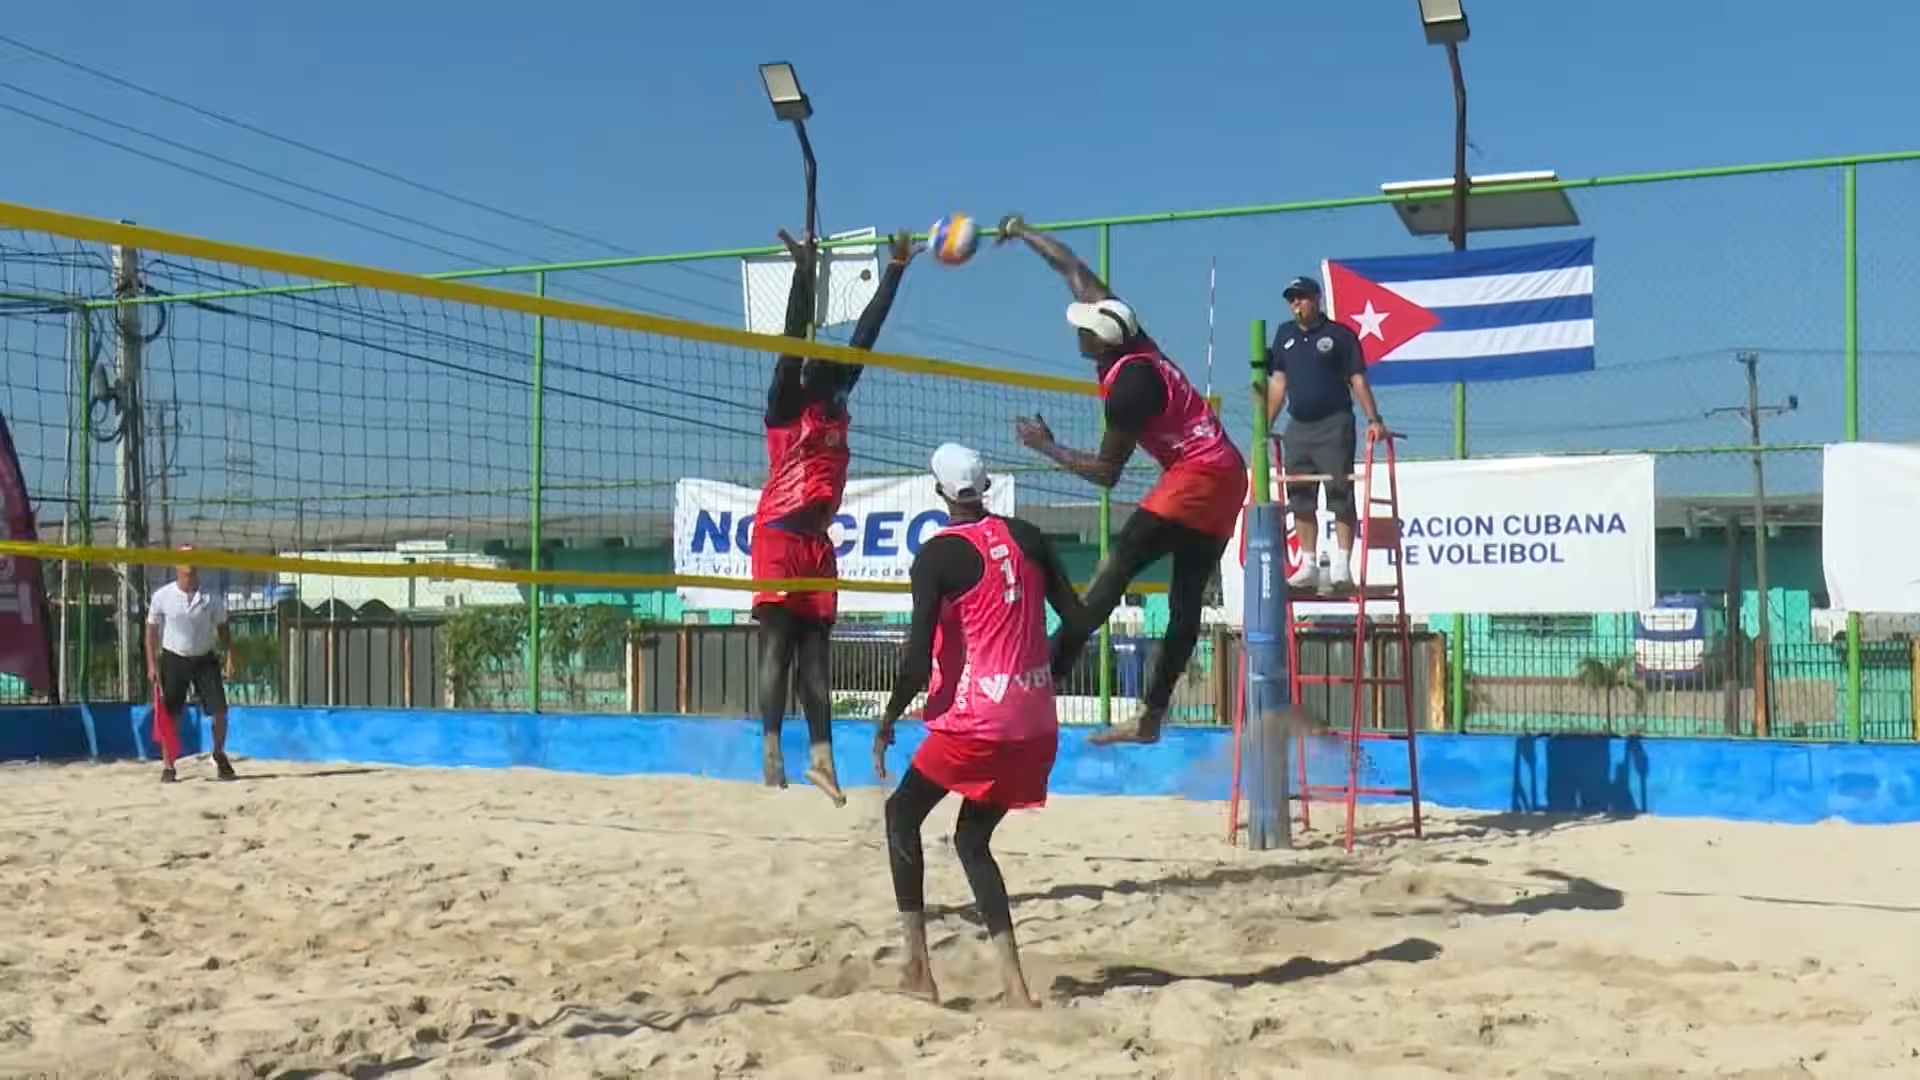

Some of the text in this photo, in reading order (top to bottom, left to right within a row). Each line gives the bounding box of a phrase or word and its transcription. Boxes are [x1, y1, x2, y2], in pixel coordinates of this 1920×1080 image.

[691, 509, 951, 557] NCEC
[1326, 513, 1627, 540] FRACION CUBANA
[1428, 542, 1565, 565] VOLEIBOL
